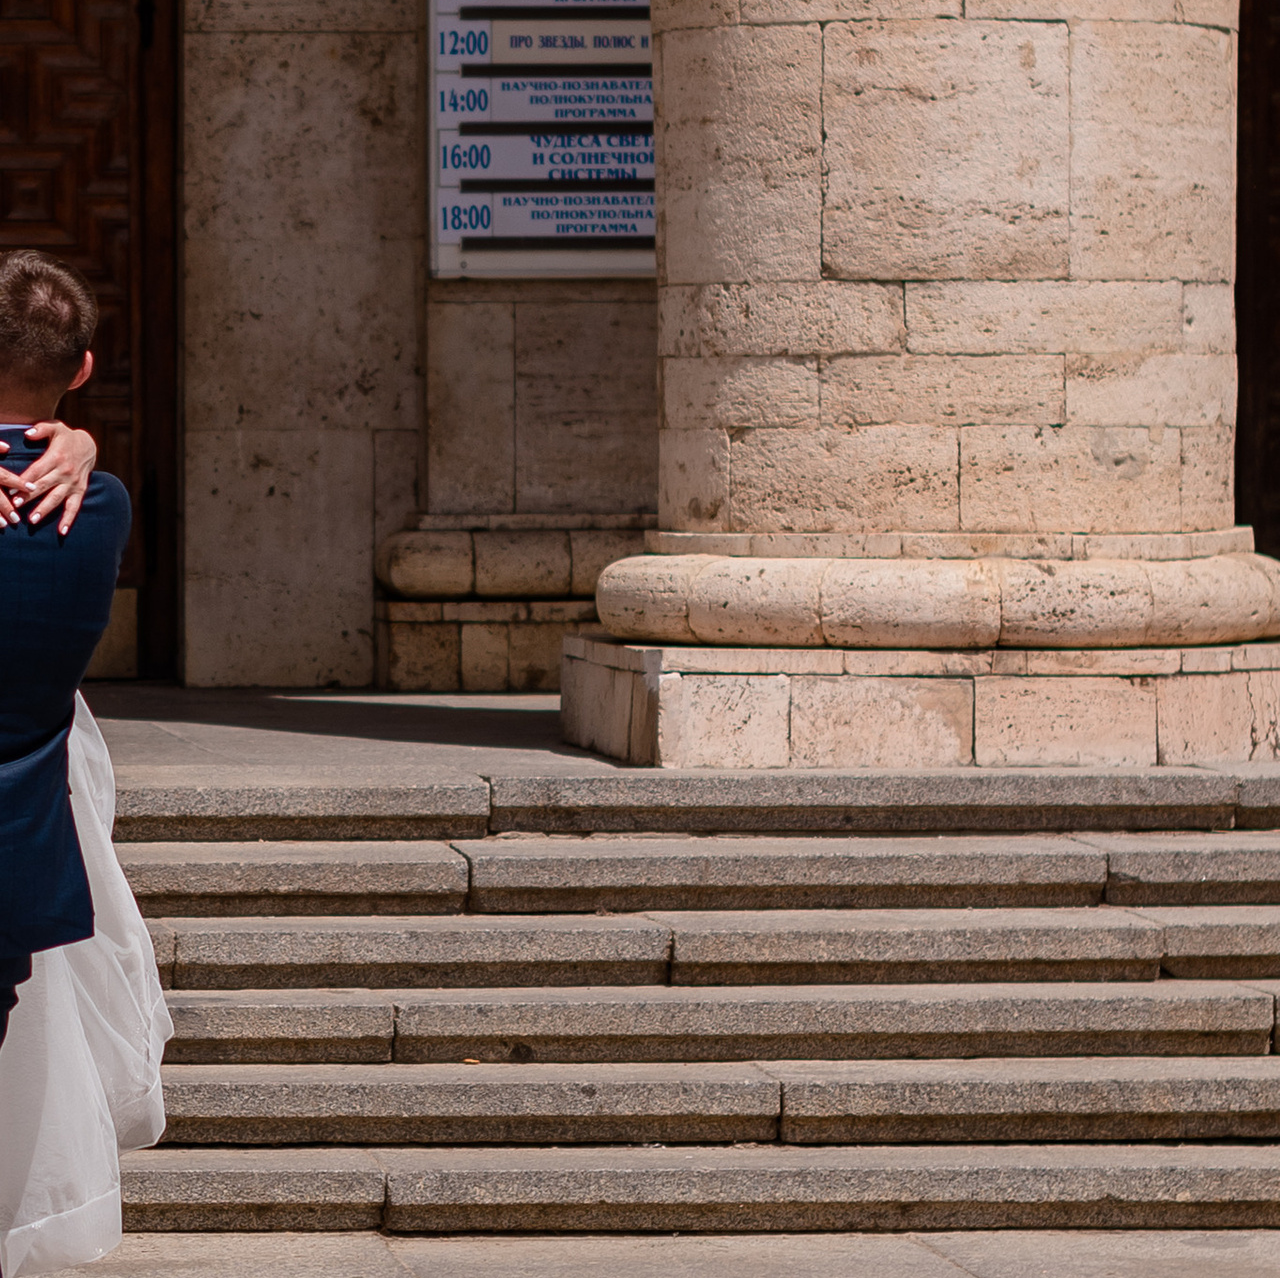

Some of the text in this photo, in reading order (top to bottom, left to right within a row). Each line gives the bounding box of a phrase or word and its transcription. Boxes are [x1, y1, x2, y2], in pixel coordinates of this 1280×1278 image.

[439, 30, 489, 55] 12:00
[510, 35, 533, 48] ПРО
[593, 35, 636, 49] ПОЛЮС
[439, 88, 489, 112] 14:00
[554, 108, 637, 119] ПРОГРАММА
[530, 134, 602, 149] ЧУДЕСА
[442, 144, 491, 169] 16:00
[532, 153, 545, 165] И
[548, 168, 637, 179] СИСТЕМЫ
[442, 205, 491, 230] 18:00
[555, 223, 638, 234] ПРОГРАММА
